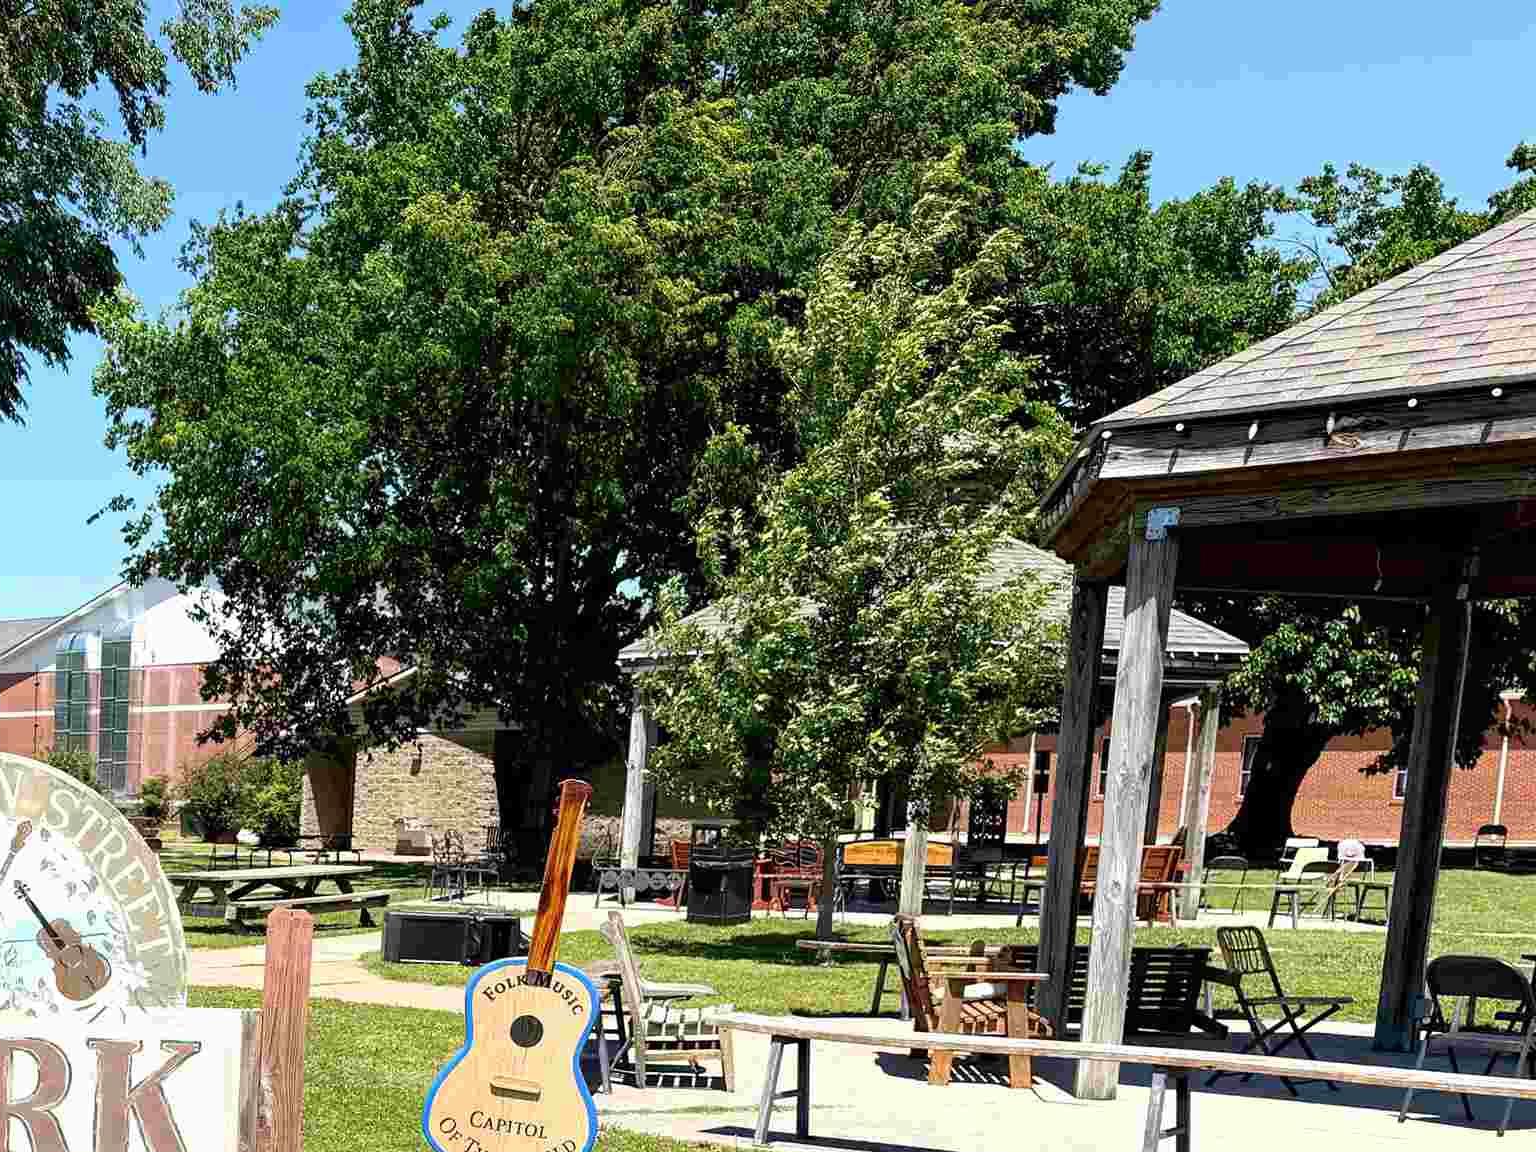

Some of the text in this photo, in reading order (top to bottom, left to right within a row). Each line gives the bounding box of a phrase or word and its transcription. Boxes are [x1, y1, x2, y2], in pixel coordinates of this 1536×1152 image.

[37, 788, 176, 957] STREET
[482, 971, 583, 1015] FOLK MUSIC
[439, 1117, 463, 1142] OF
[469, 1110, 548, 1139] CAPITOL
